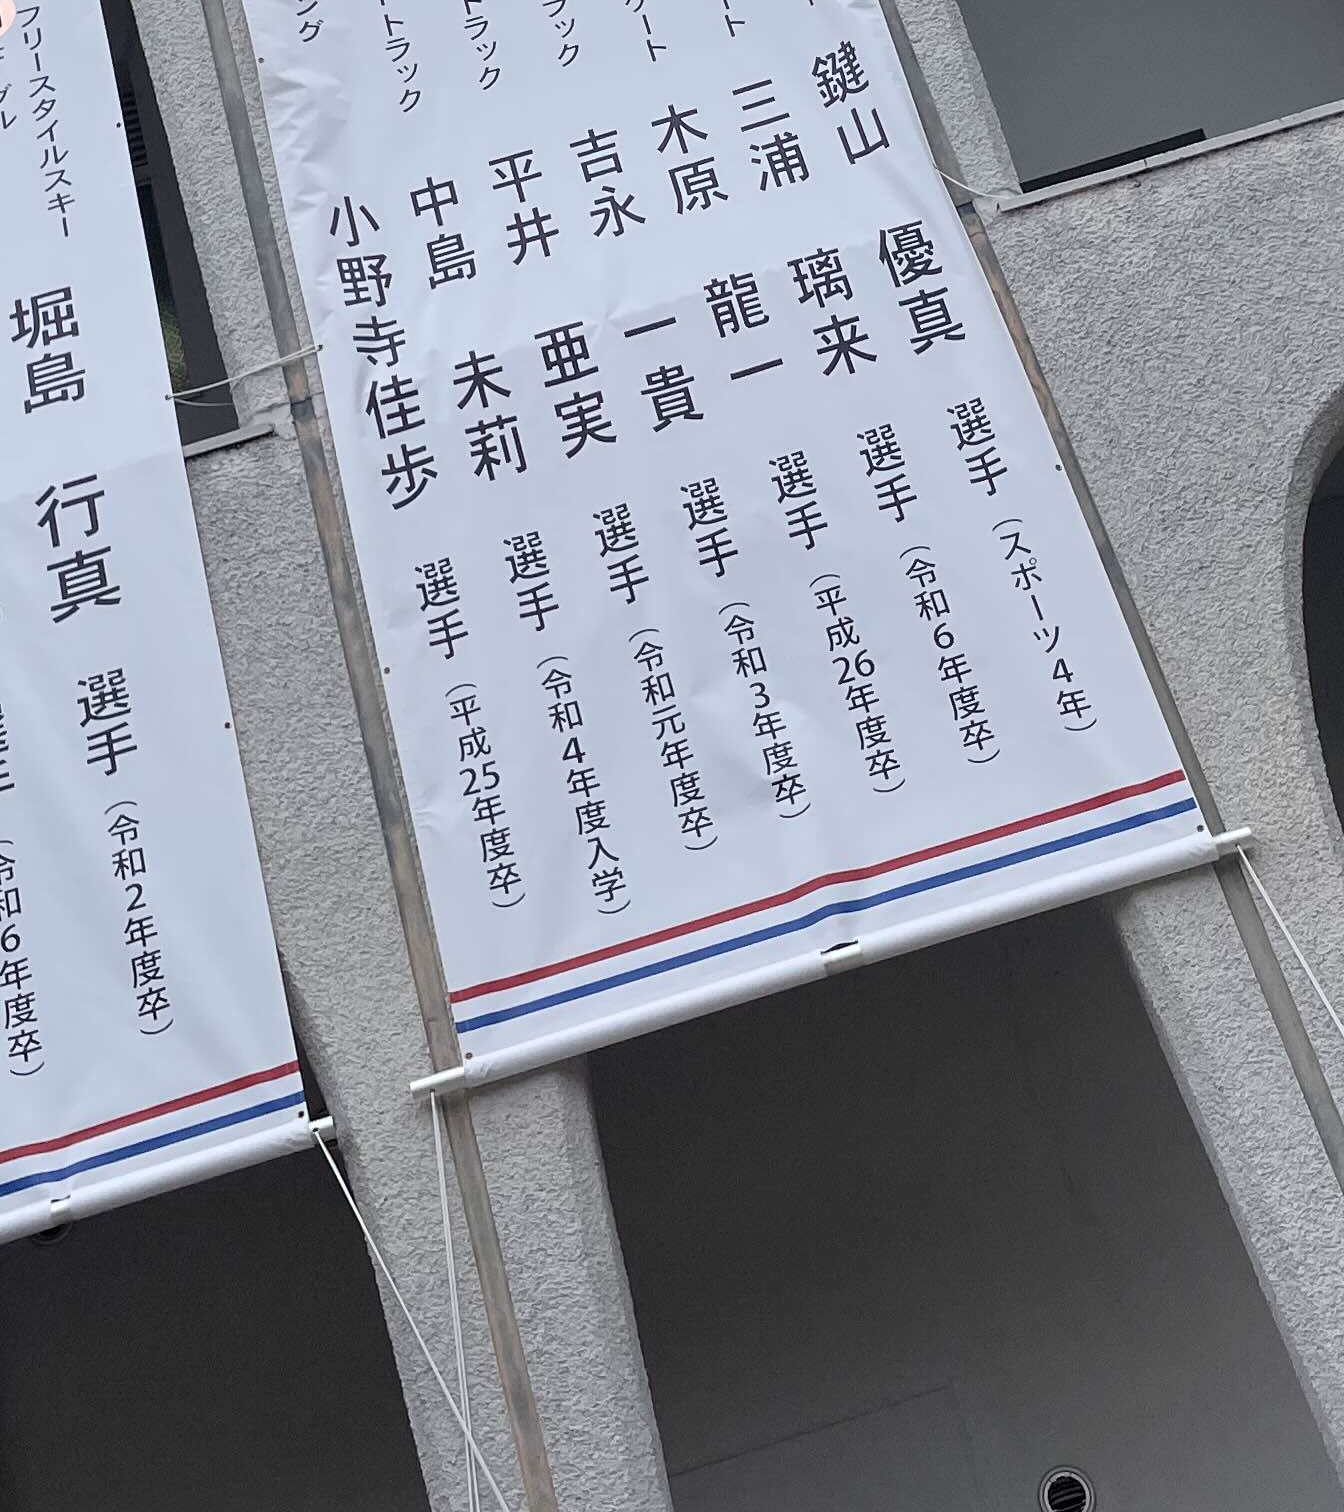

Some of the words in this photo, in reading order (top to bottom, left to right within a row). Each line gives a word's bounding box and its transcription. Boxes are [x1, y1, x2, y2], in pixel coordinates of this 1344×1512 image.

[9, 286, 85, 414] 堀島
[16, 6, 75, 237] フリースタイルスキー
[812, 41, 890, 165] 鍵山
[879, 220, 965, 355] 優真
[947, 397, 1008, 496] 選手
[35, 474, 121, 623] 行真
[330, 196, 438, 510] 小野寺佳歩
[415, 557, 469, 660] 選手
[445, 684, 525, 908] （平成25年度卒）
[410, 177, 476, 290] 中島
[453, 350, 527, 481] 未莉
[503, 531, 559, 631] 選手
[537, 656, 631, 914] （令和4年度入学）
[489, 149, 559, 265] 平井
[534, 321, 617, 459] 亜実
[593, 503, 649, 605] 選手
[628, 629, 718, 850] （令和元年度卒）
[570, 129, 646, 237] 吉永
[624, 317, 704, 432] 一貴
[680, 477, 738, 578] 選手
[719, 603, 811, 818] （令和3年度卒）
[651, 104, 728, 215] 木原
[704, 272, 783, 380] 龍一
[769, 450, 828, 550] 選手
[809, 574, 905, 793] （平成26年度卒）
[732, 79, 809, 191] 三浦
[787, 248, 877, 376] 璃来
[857, 424, 917, 523] 選手
[899, 546, 1000, 763] （令和6年度卒）
[77, 668, 137, 776] 選手
[104, 801, 173, 1035] （令和2年度卒）
